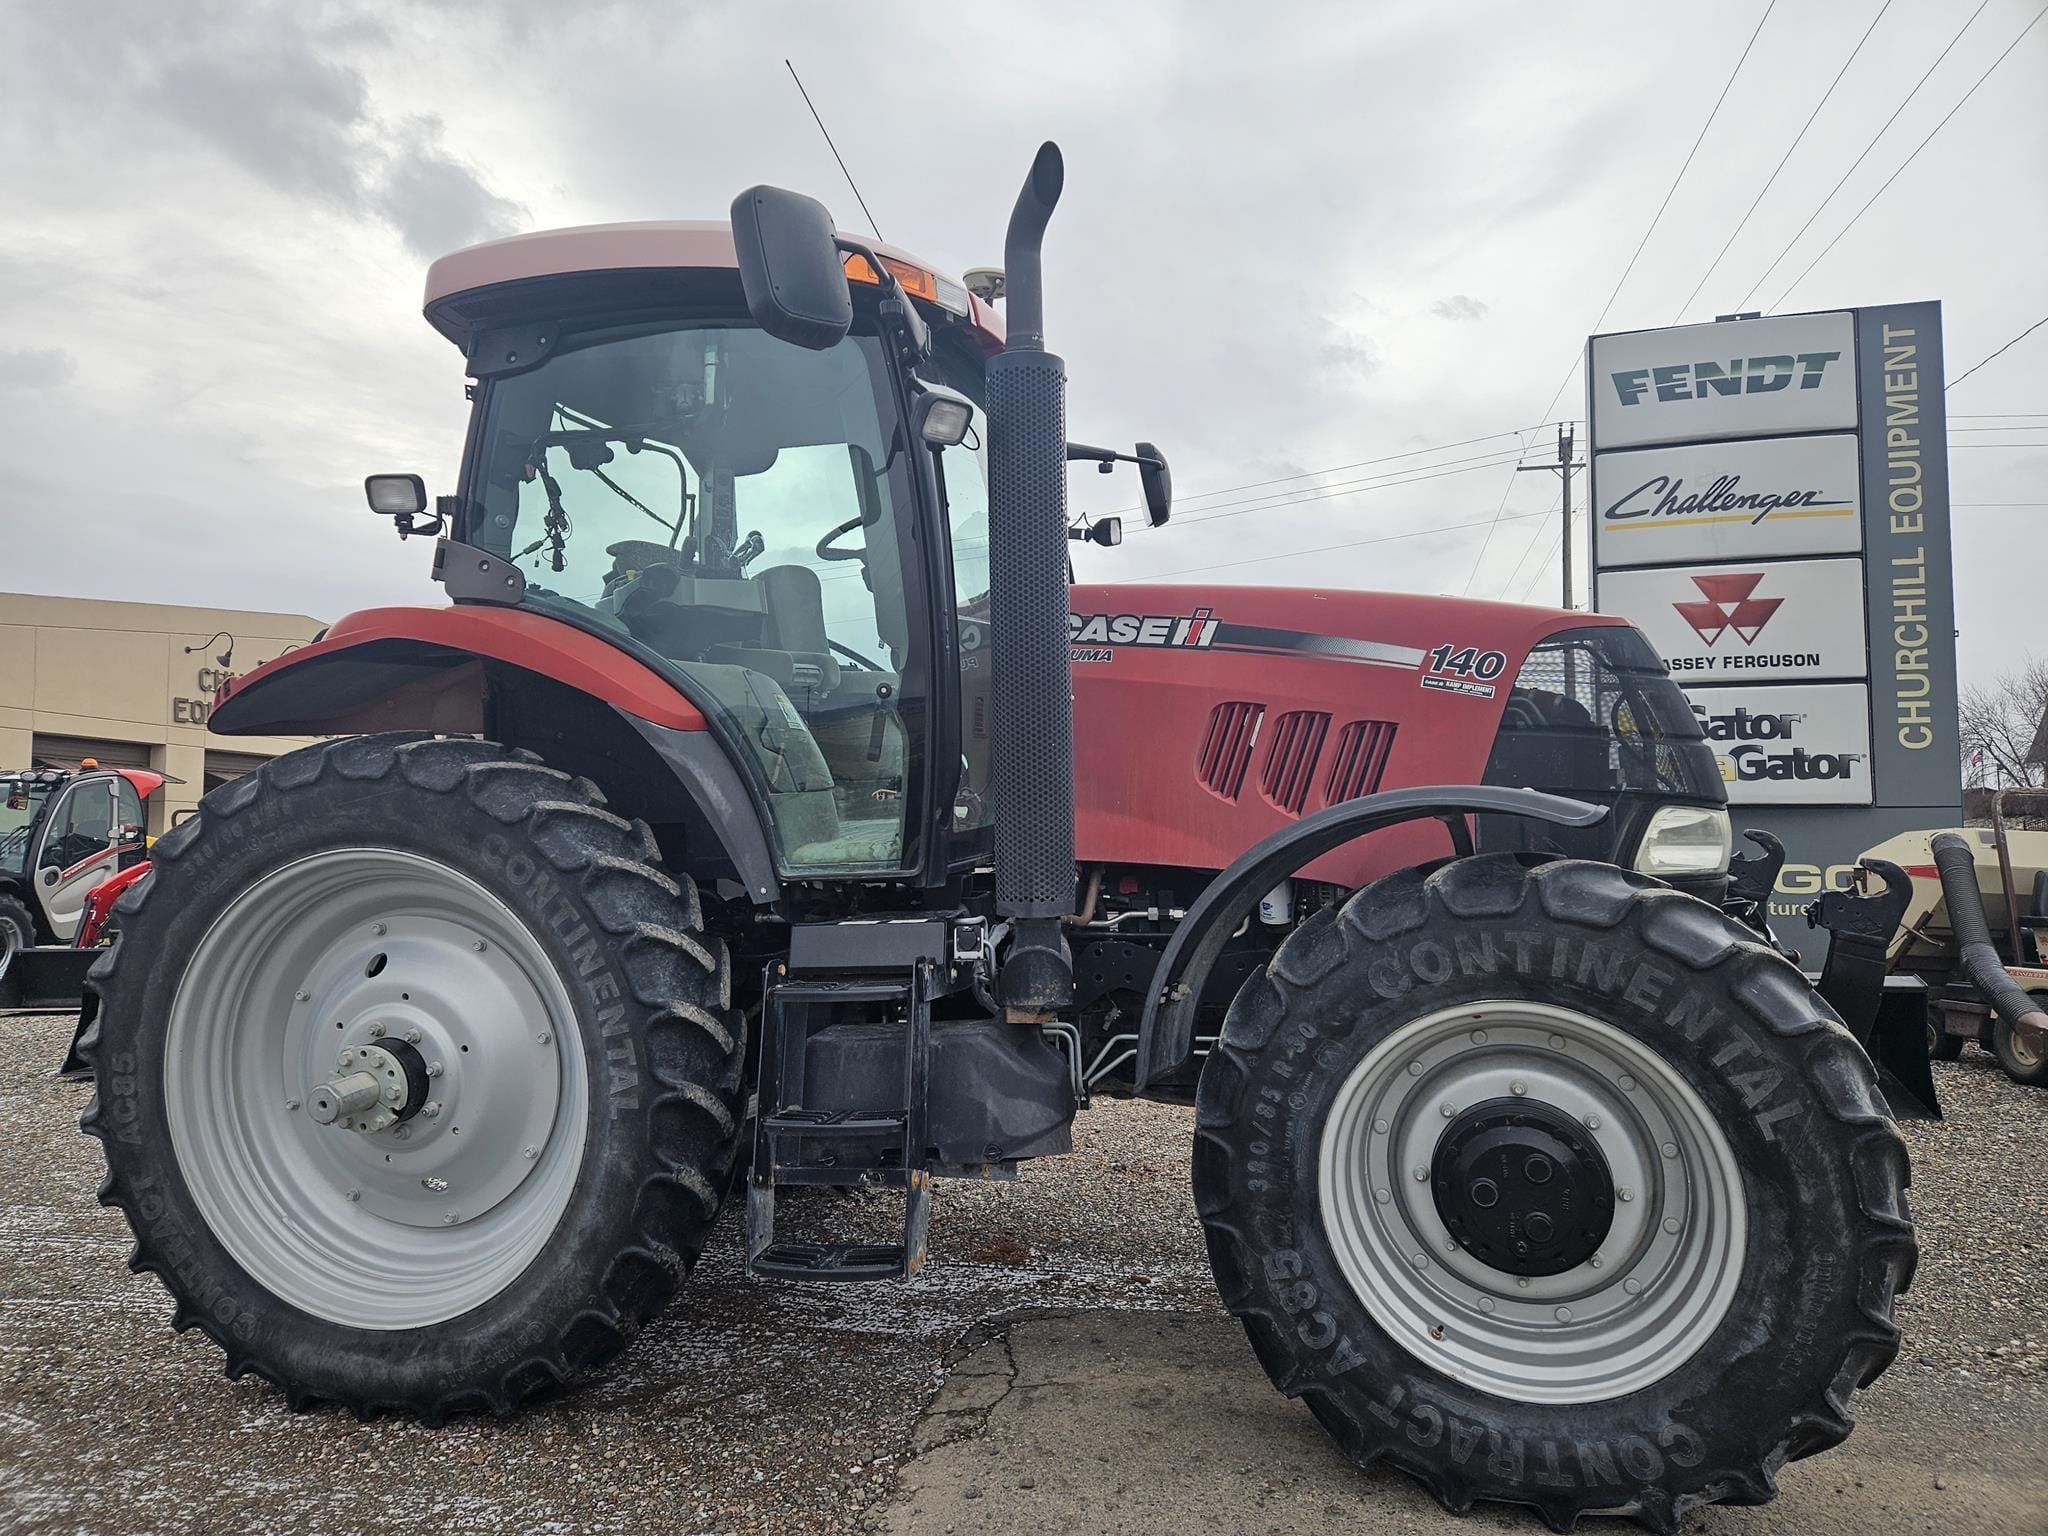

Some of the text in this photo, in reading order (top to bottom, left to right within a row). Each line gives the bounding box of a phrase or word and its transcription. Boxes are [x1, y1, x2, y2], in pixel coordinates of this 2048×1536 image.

[1610, 351, 1841, 406] FENDT
[1604, 475, 1854, 526] Challenger
[1882, 323, 1934, 750] CHURCHILL EQUIPMENT
[1070, 648, 1113, 663] UMA
[1430, 643, 1506, 680] 140
[1662, 653, 1820, 671] ASSEY FERGUSON
[481, 833, 640, 1121] CONTINENTAL
[1367, 931, 1804, 1142] CONTINENTAL
[1367, 1385, 1705, 1488] CONTRACT
